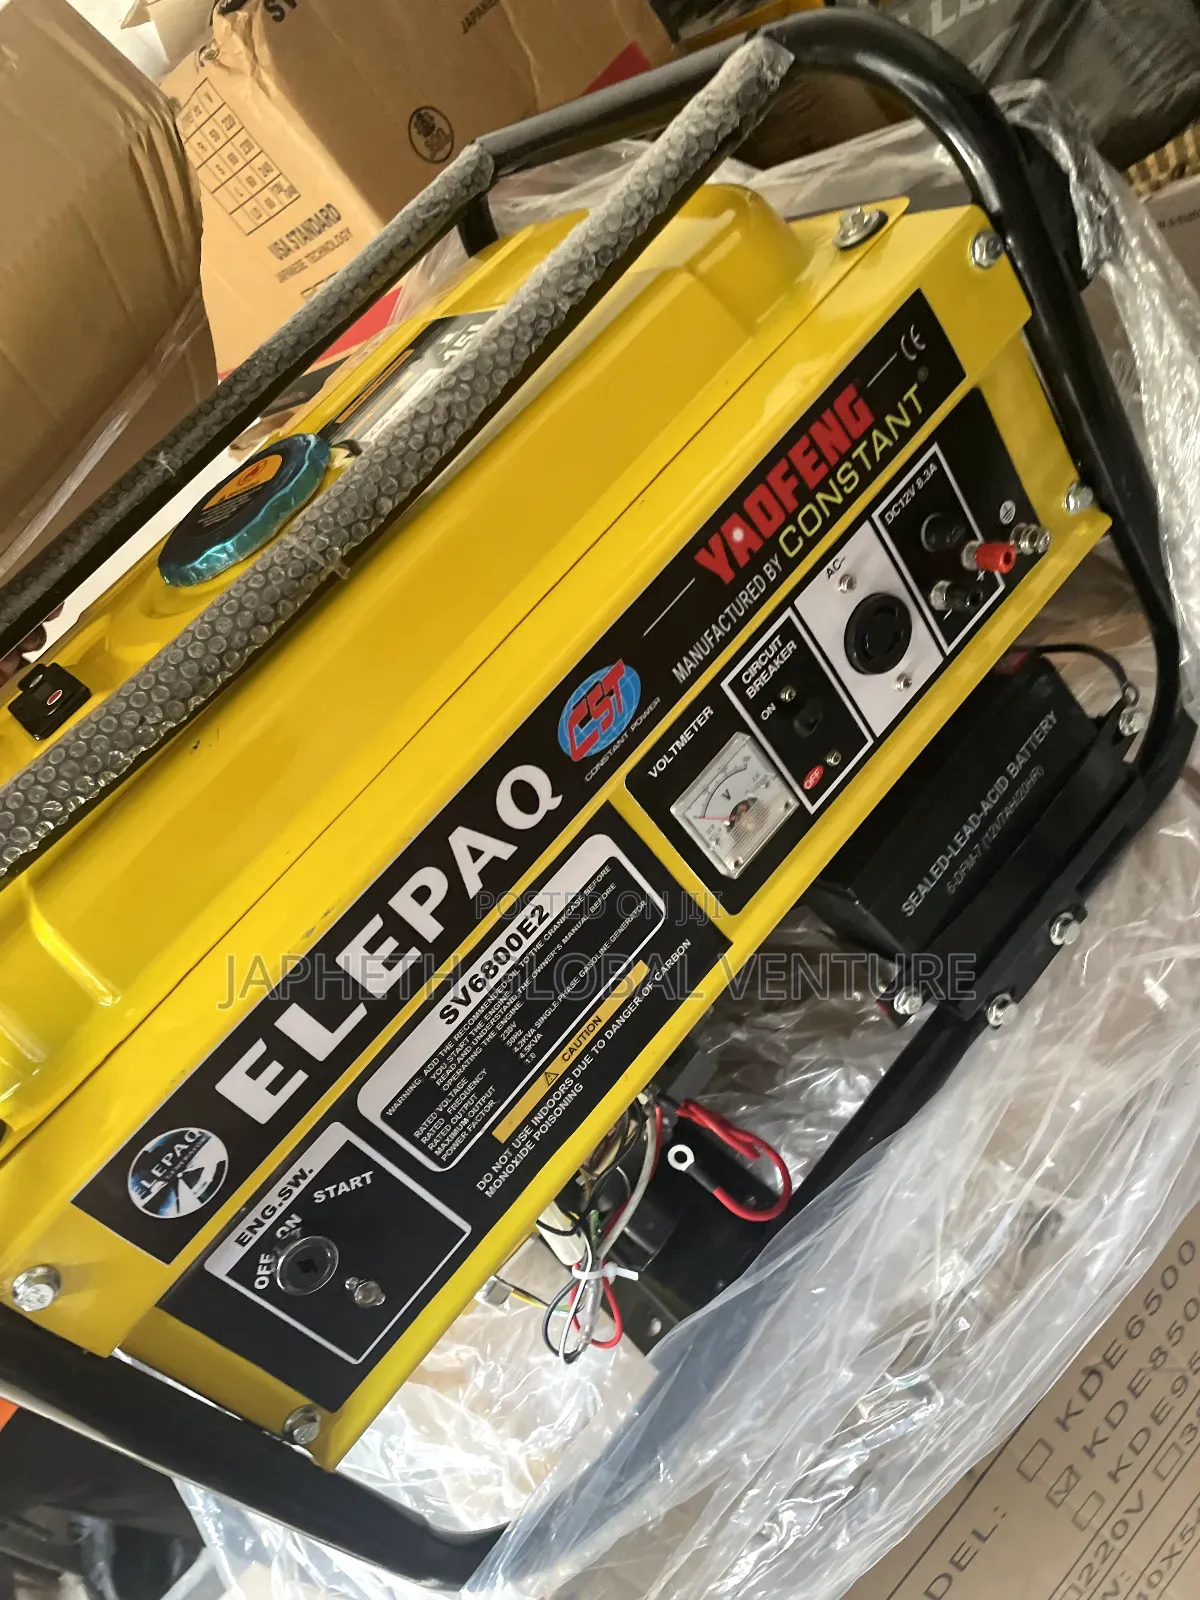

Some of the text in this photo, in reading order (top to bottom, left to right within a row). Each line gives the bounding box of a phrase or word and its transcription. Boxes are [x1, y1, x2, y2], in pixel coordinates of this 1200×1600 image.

[285, 203, 342, 251] STANDARD
[694, 382, 875, 585] YAOFENG
[778, 383, 925, 558] CONSTANT
[884, 462, 938, 525] DC12V 8.3A
[671, 553, 782, 684] MANUFACTURED BY
[741, 634, 782, 684] CIRCUIT
[745, 640, 797, 700] BREAKER
[761, 702, 776, 720] ON
[584, 696, 661, 782] CONSTANT POWER
[648, 705, 714, 778] VOLTMETER
[803, 770, 821, 790] OFF
[901, 710, 1057, 917] SEALED-LEAD-ACID BATTERY
[214, 764, 563, 1125] ELEPAQ
[423, 1058, 439, 1076] ADD
[438, 1040, 455, 1056] THE
[453, 981, 507, 1041] RECOMMENDED
[507, 969, 520, 982] OIL
[518, 956, 529, 967] TO
[528, 940, 544, 956] THE
[544, 895, 585, 941] CRANKCASE
[583, 864, 611, 896] BEFORE
[436, 882, 616, 1086] READ AND UNDERSTAND THE OWNER'S MANUAL BEFORE
[439, 904, 550, 1025] SV6800E2
[428, 900, 647, 1150] RATED OUTPUT 4.2KVA SINGLE PHASE GASOLINE GENERATOR
[430, 1062, 447, 1079] YOU
[446, 1036, 469, 1063] START
[468, 1020, 485, 1036] THE
[442, 1046, 482, 1091] OPERATING
[480, 1030, 497, 1045] THE
[476, 938, 692, 1191] DO NOT USE INDOORS DUE TO DANGER OF CARBON
[562, 1015, 602, 1062] CAUTION
[414, 1020, 516, 1138] RATED VOLTAGE 230V
[420, 1029, 523, 1144] RATED FREQUENCY 50Hz
[434, 1033, 543, 1156] MAXIMUM OUTPUT 4.5KVA
[132, 1129, 202, 1197] ELEPAQ
[440, 1131, 468, 1161] POWER
[466, 1100, 496, 1132] FACTOR
[484, 1083, 583, 1198] MONOXIDE POISONING
[275, 1213, 302, 1239] ON
[313, 1171, 374, 1203] START
[254, 1253, 275, 1290] OFF
[1054, 1240, 1196, 1432] KDE6500
